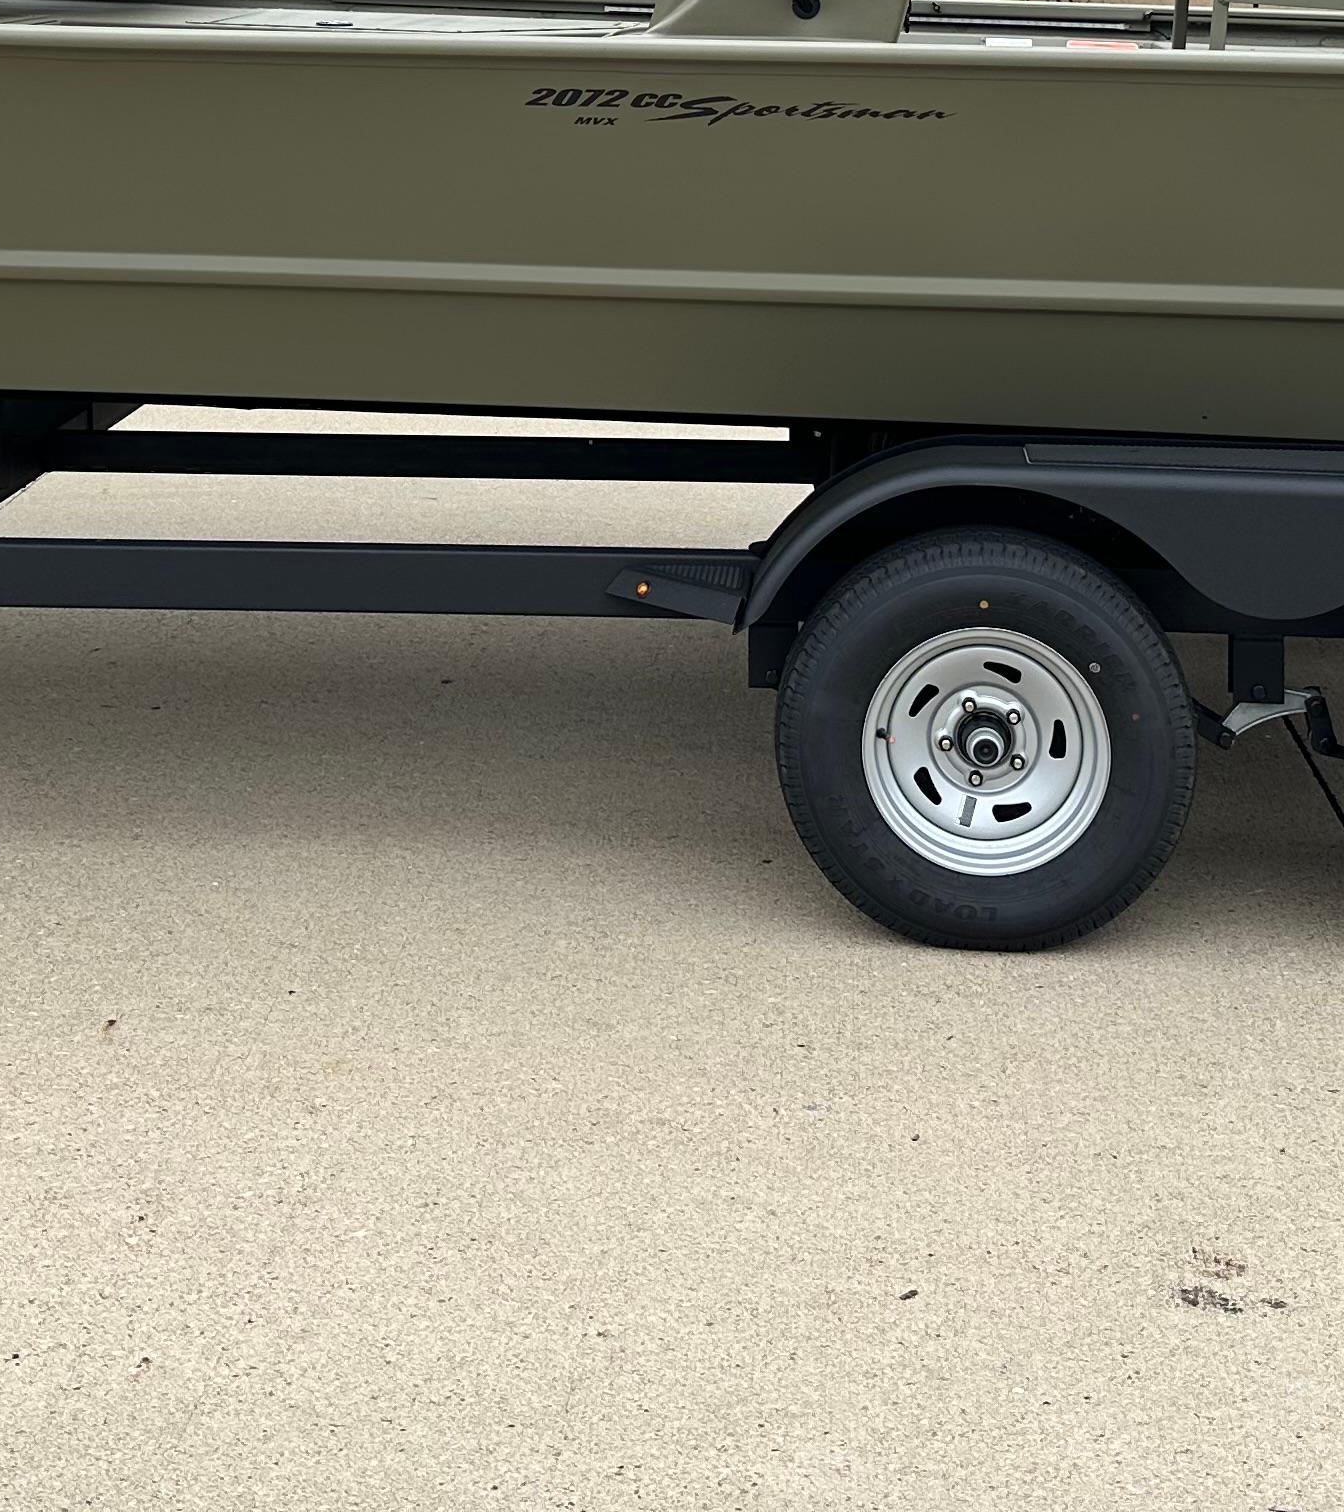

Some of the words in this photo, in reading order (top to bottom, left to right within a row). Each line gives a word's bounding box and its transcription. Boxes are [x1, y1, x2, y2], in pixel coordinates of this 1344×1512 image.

[524, 88, 631, 108] 2072
[630, 92, 682, 109] CC
[644, 95, 958, 126] Sportsman
[574, 115, 618, 127] MVX
